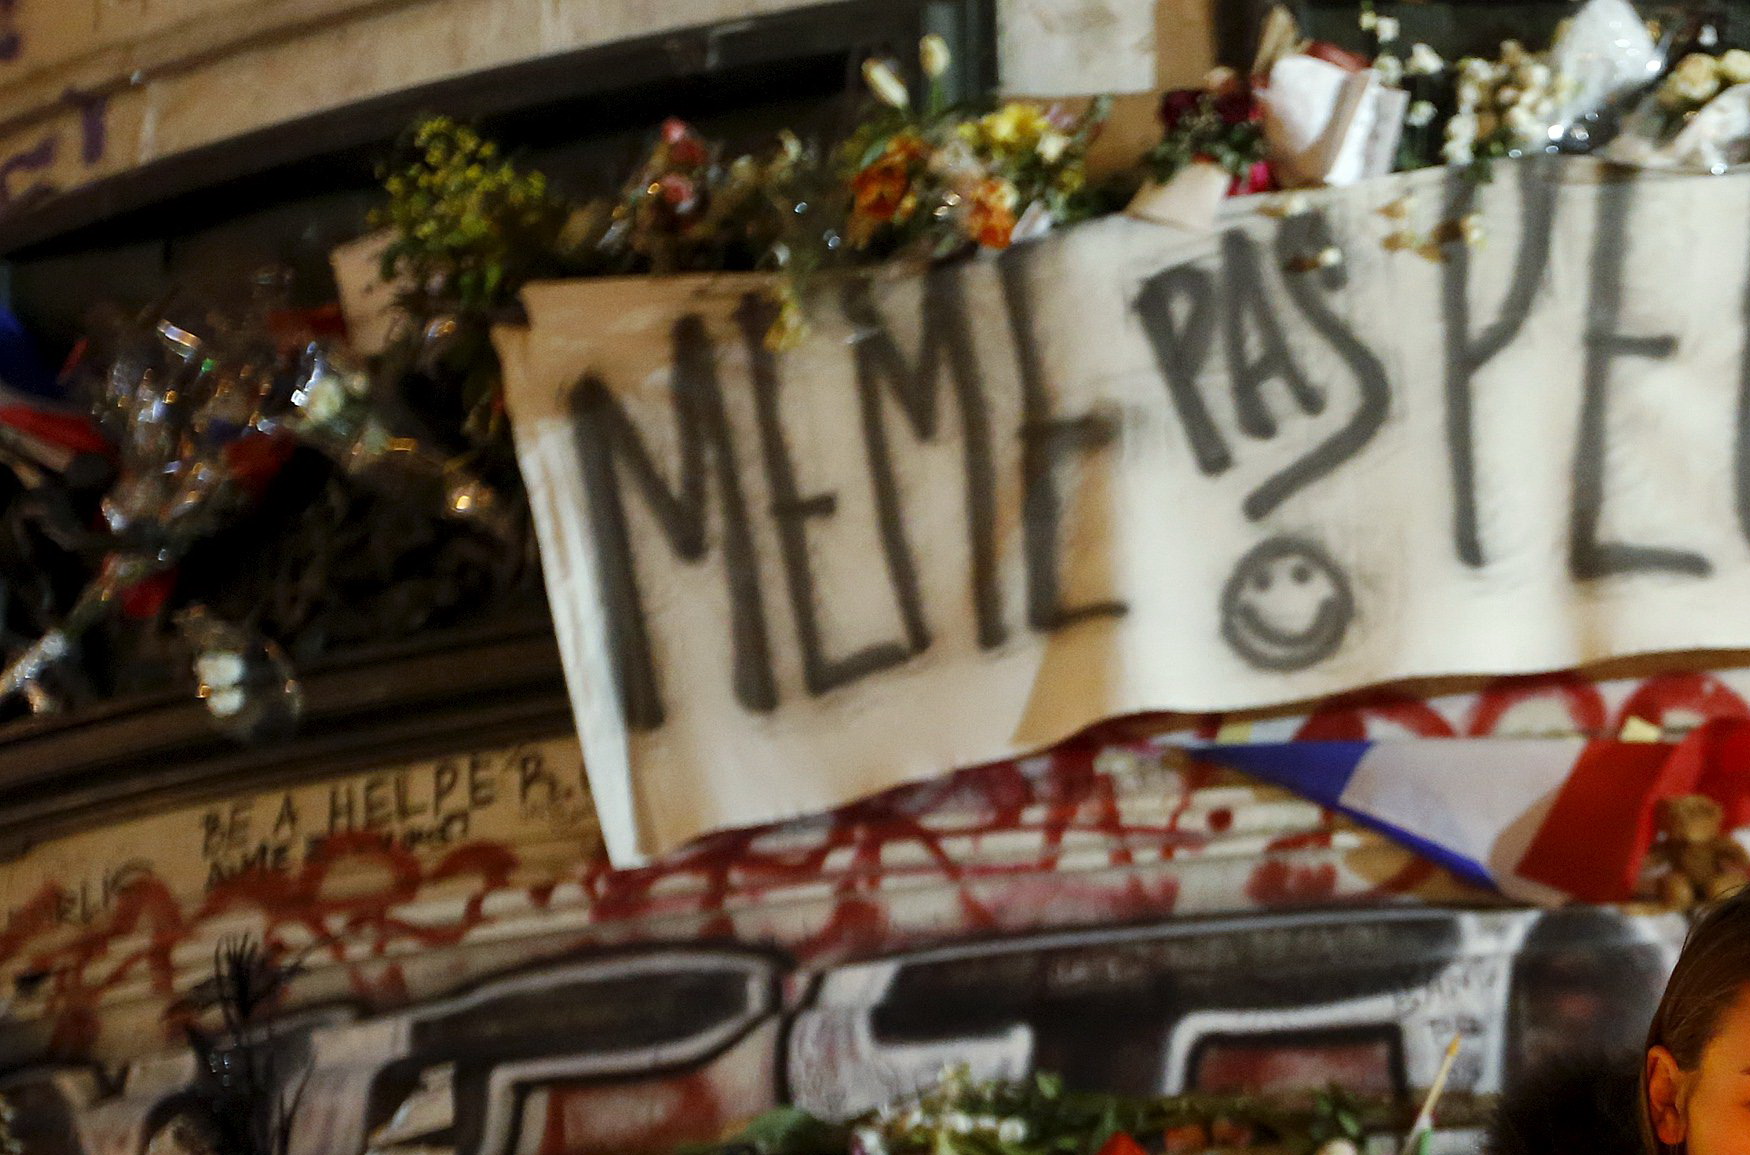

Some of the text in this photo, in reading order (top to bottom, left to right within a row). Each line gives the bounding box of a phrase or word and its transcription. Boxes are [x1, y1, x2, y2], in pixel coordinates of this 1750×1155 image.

[567, 240, 1128, 730] MEME
[1133, 205, 1392, 520] PAS
[203, 802, 250, 858] BE
[273, 794, 299, 837] A
